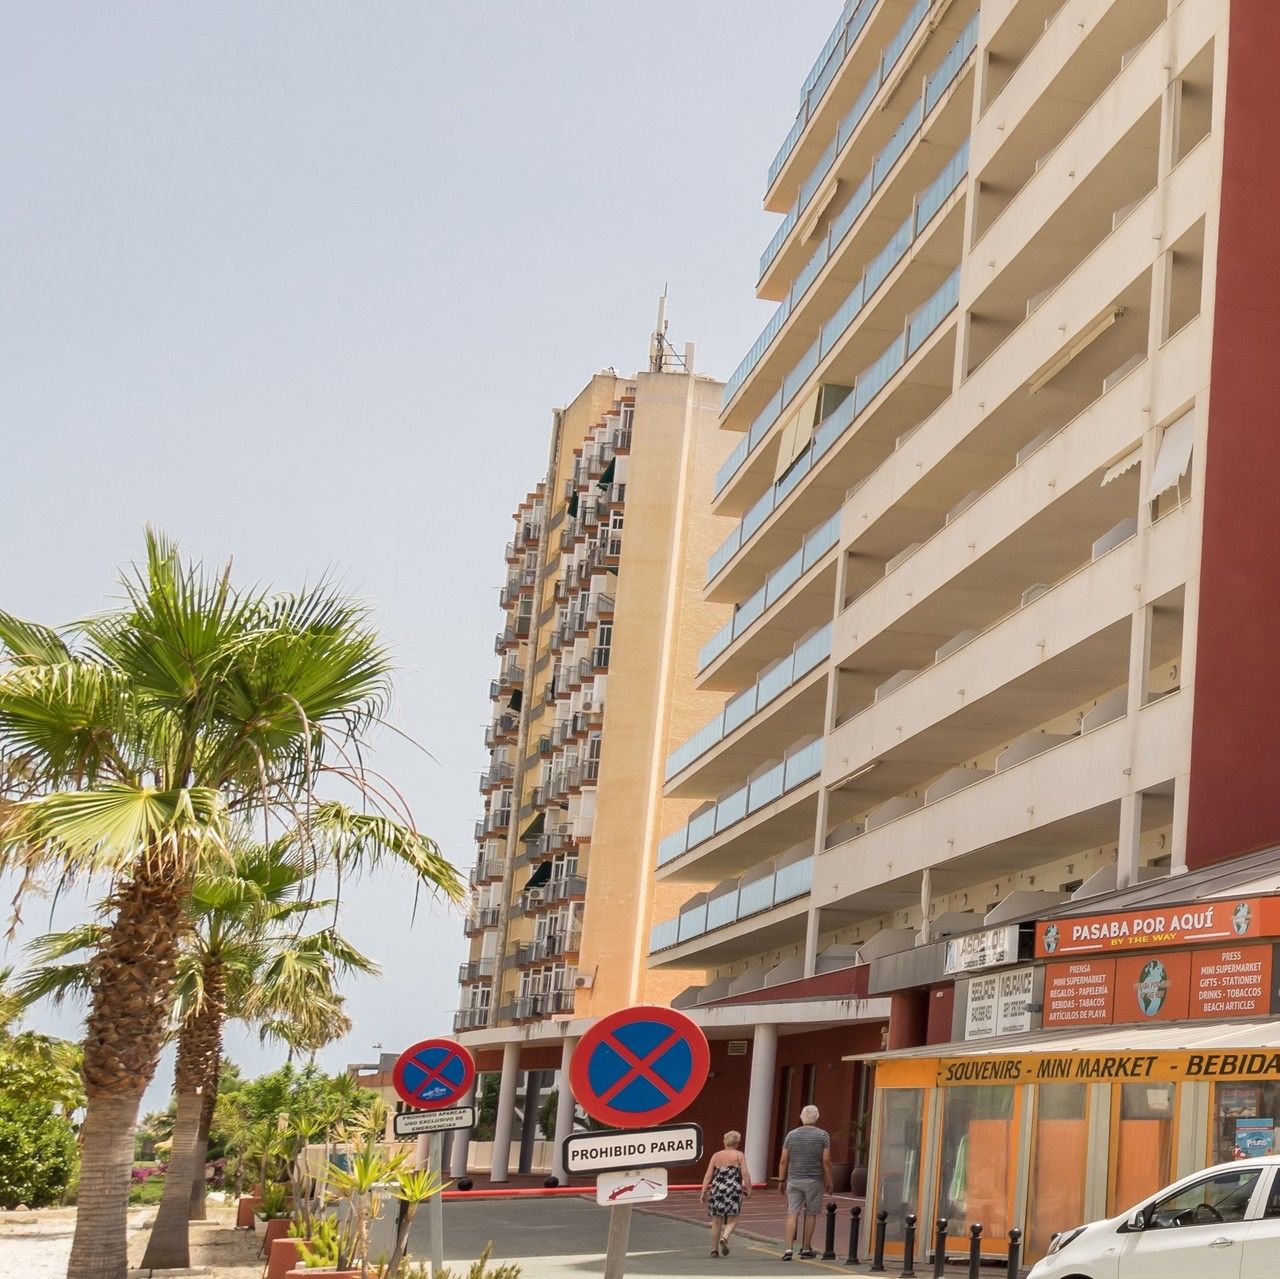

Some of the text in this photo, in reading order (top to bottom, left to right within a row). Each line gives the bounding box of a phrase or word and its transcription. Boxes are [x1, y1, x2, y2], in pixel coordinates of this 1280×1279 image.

[1072, 921, 1130, 941] PASABA
[1133, 916, 1166, 936] POR
[1169, 906, 1214, 932] AQUÍ
[1110, 932, 1177, 946] BY THE WAY
[1221, 951, 1242, 962] PRESS
[1069, 964, 1091, 974] PRENSA
[1200, 962, 1262, 975] MINI SUPERMARKET
[1053, 974, 1106, 987] MINI SUPERMARKET
[1199, 975, 1262, 987] GIFTS STATIONERY
[1050, 988, 1075, 998] REGALOS
[1198, 987, 1262, 1000] DRINKS TOBACCOS
[1051, 998, 1105, 1009] BEBIDAS TABACOS
[1203, 1000, 1255, 1012] BEACH ARTICLES
[1088, 1010, 1106, 1018] PLAYA
[945, 1059, 1021, 1082] SOUVENIRS
[1036, 1058, 1072, 1079] MINI
[1075, 1056, 1159, 1078] MARKET
[420, 1116, 454, 1124] EXCLUSIVO
[412, 1122, 457, 1132] EMERGENCIAS
[571, 1139, 694, 1162] PROHIBIDO PARAR
